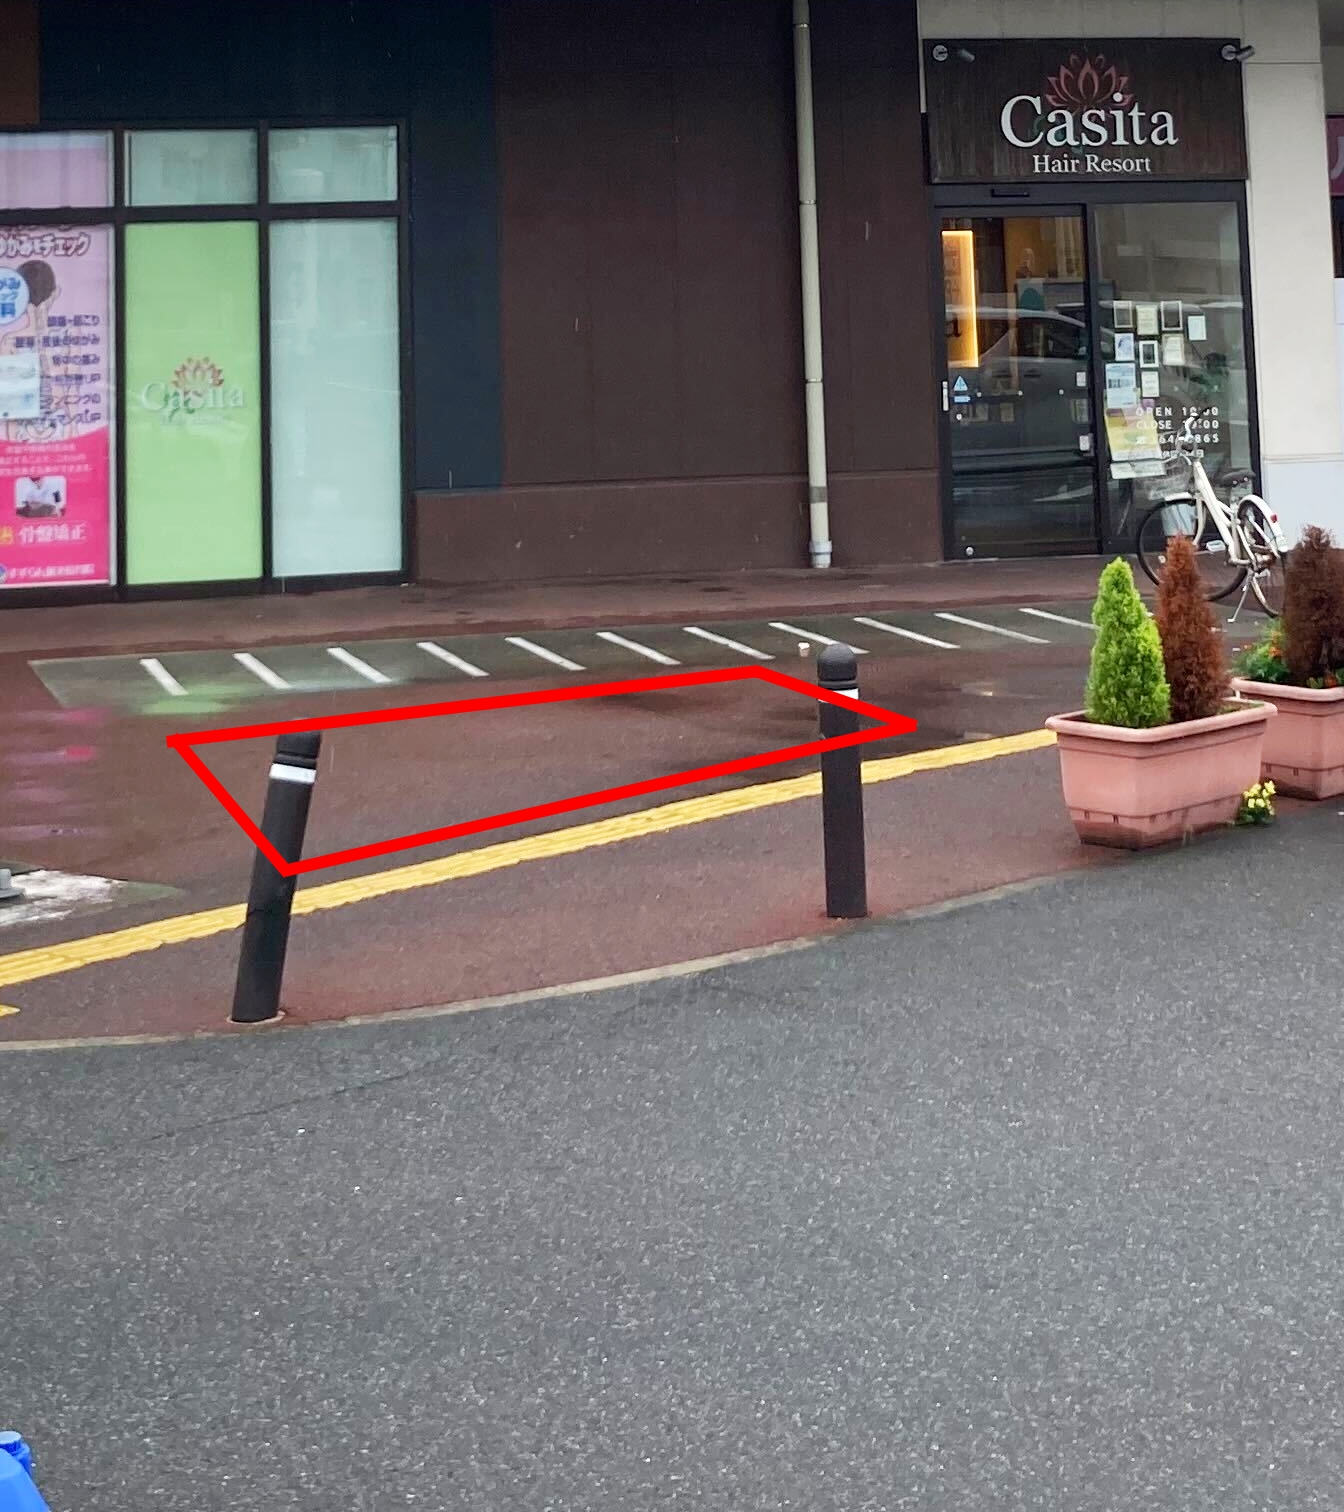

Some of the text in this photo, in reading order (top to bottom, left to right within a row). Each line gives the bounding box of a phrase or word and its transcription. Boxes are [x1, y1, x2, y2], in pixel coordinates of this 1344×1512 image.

[1000, 91, 1180, 150] Casita
[1032, 153, 1152, 174] Hair Resort
